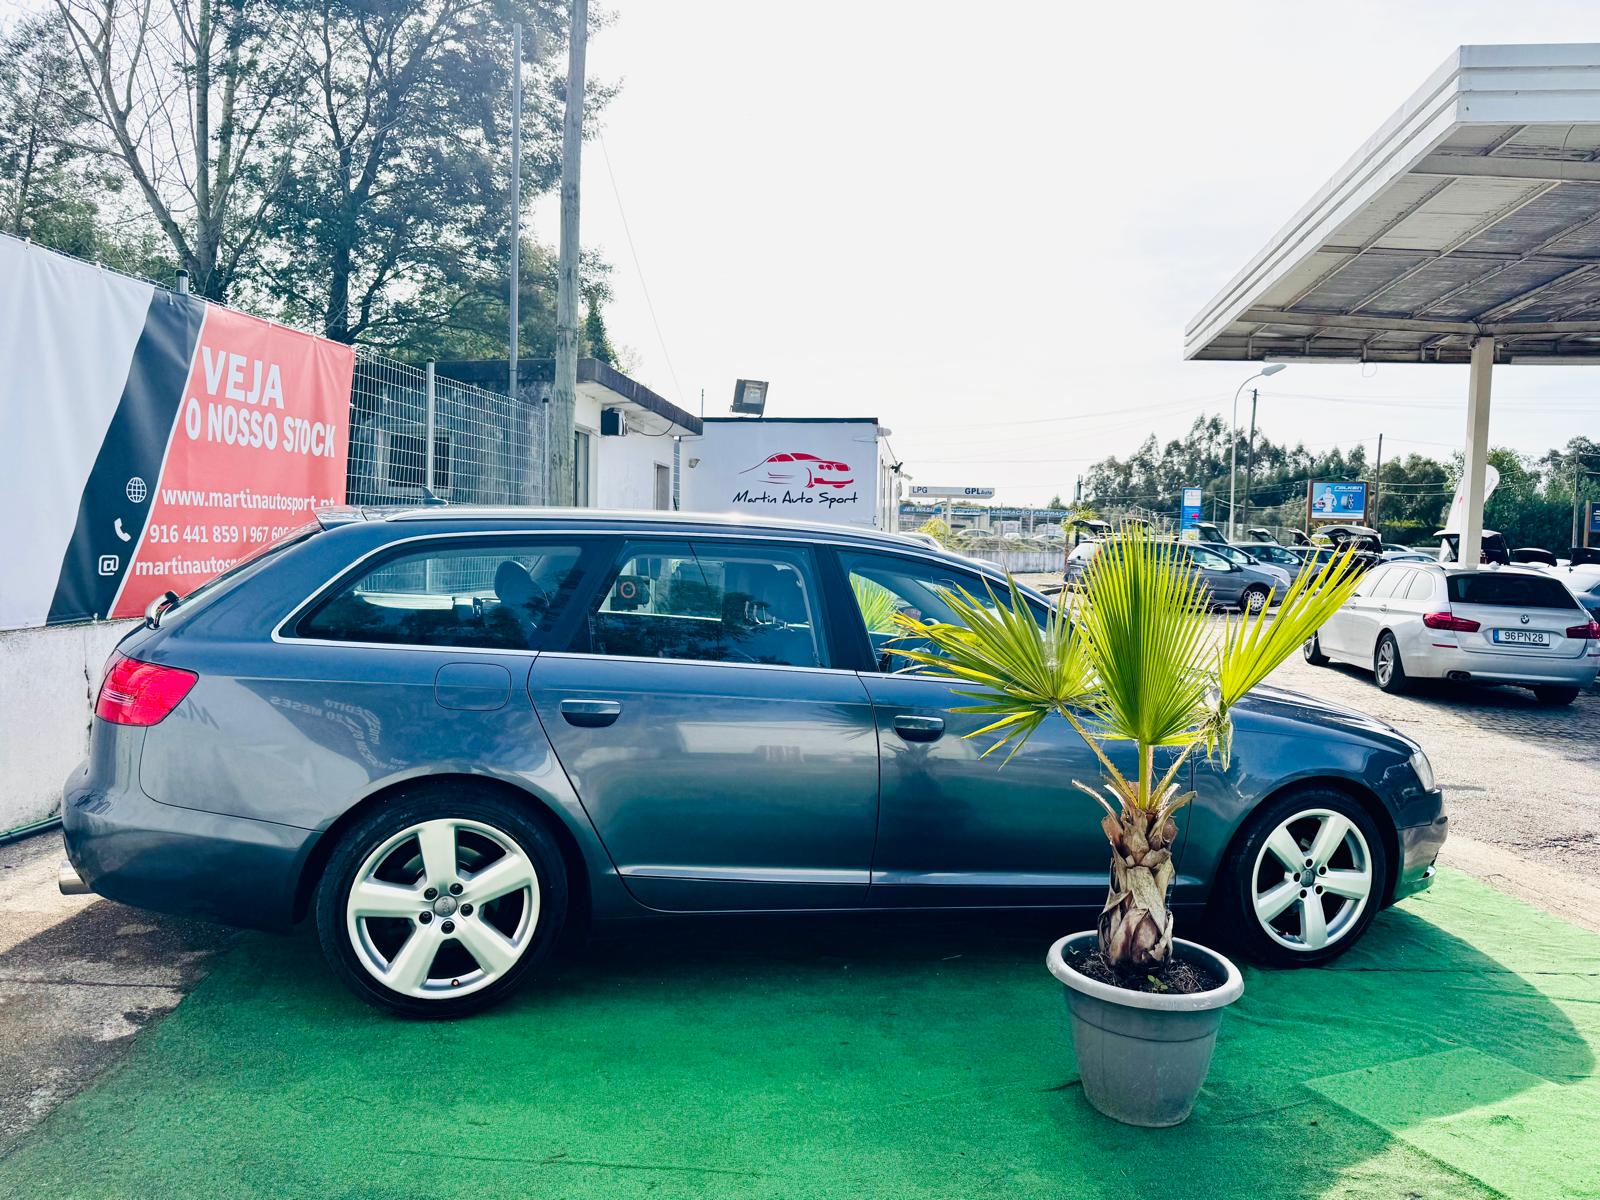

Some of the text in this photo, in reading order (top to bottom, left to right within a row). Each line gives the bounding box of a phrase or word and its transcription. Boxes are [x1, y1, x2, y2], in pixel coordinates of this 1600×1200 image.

[202, 346, 285, 409] VEJA
[185, 397, 336, 458] O NOSSO STOCK
[732, 490, 859, 509] Martin Auto Sport
[912, 486, 928, 494] LPG
[964, 487, 981, 495] GPL
[161, 489, 335, 516] www.martinautosportt
[150, 524, 179, 543] 916
[183, 525, 209, 543] 441
[212, 525, 239, 543] 859
[250, 526, 269, 543] 967
